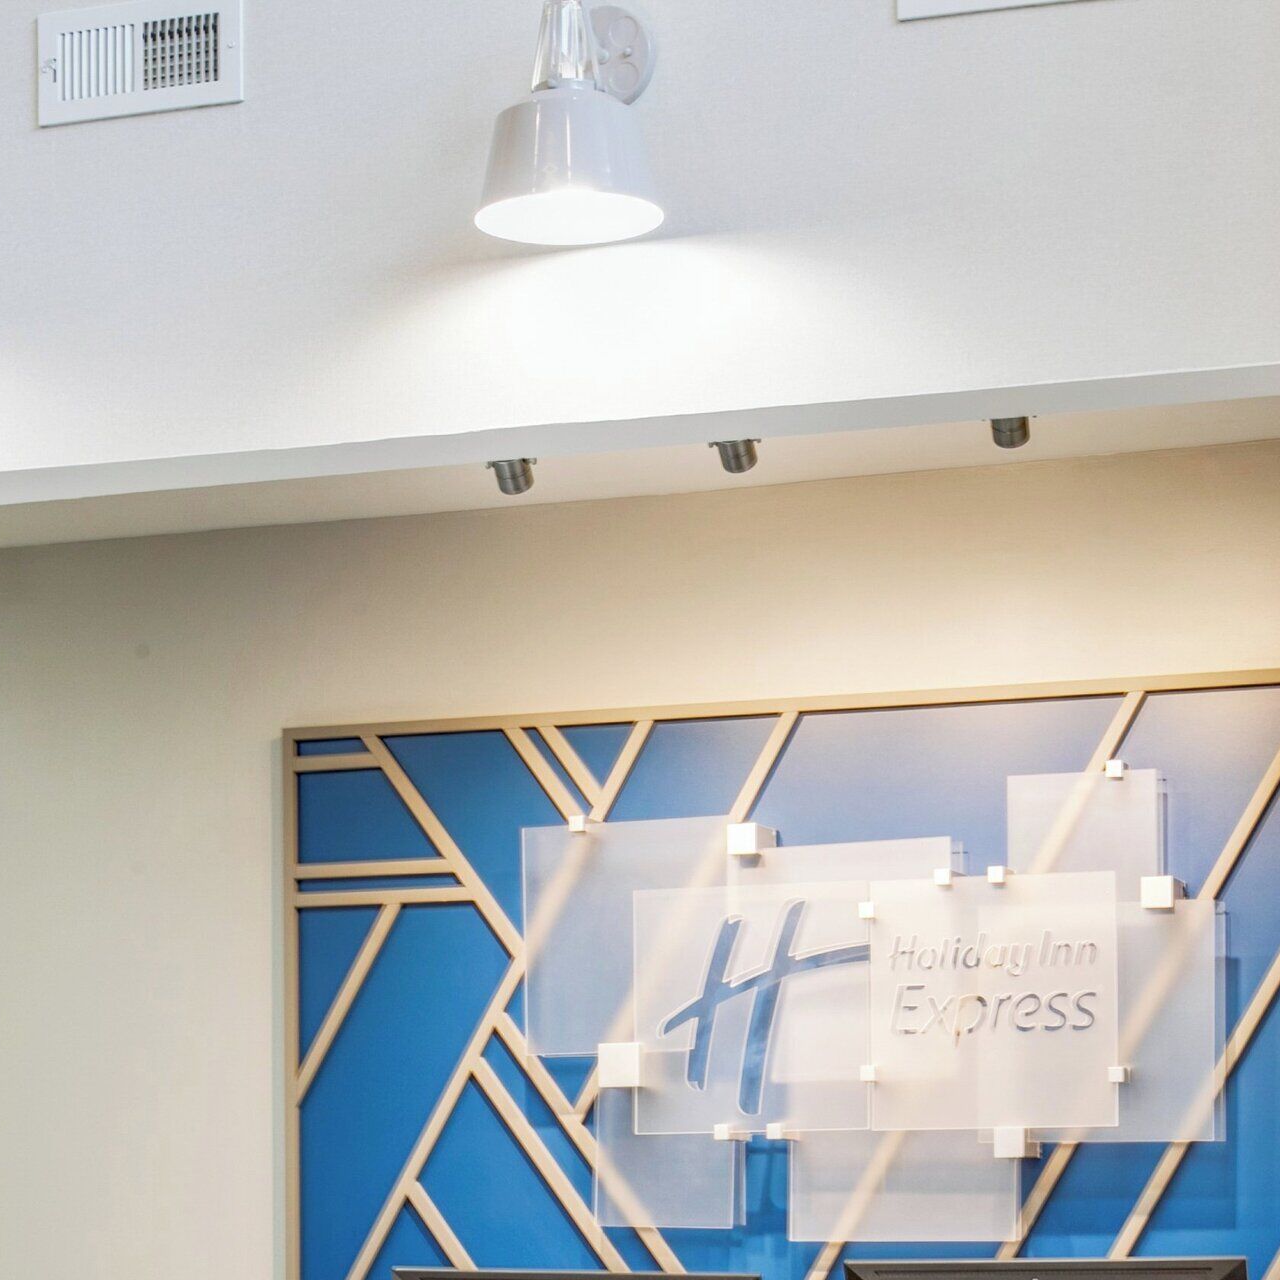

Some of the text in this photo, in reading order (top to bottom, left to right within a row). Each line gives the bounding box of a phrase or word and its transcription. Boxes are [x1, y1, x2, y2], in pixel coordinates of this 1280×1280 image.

[888, 929, 1098, 977] Holiday Inn
[889, 983, 1099, 1048] Express
